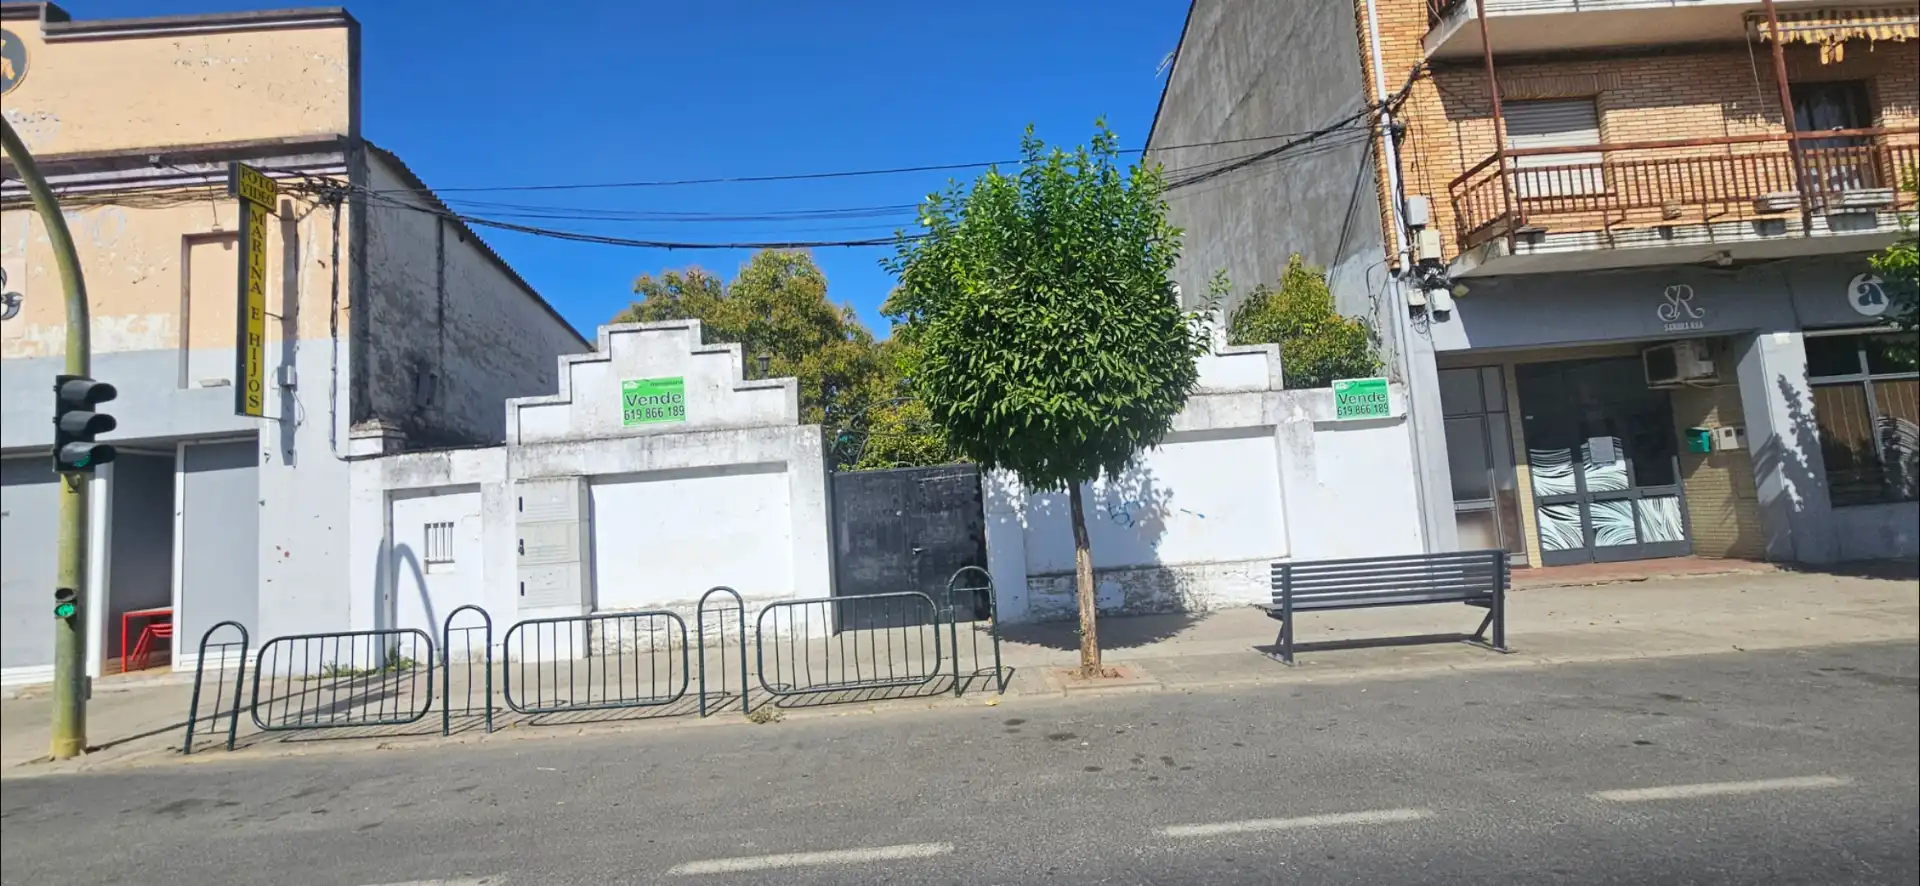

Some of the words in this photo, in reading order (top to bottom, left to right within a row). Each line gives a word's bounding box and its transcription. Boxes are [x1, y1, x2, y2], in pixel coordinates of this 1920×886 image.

[241, 167, 274, 192] FOTO
[241, 181, 274, 206] VIDEO
[250, 209, 263, 295] MARINA
[251, 306, 261, 320] E
[248, 332, 261, 408] HIJOS
[626, 391, 682, 407] Vende
[1338, 392, 1386, 404] Vende
[624, 409, 642, 421] 619
[645, 407, 664, 419] 866
[668, 405, 685, 416] 189
[1337, 406, 1353, 416] 619
[1355, 405, 1371, 414] 866
[1374, 403, 1389, 413] 189
